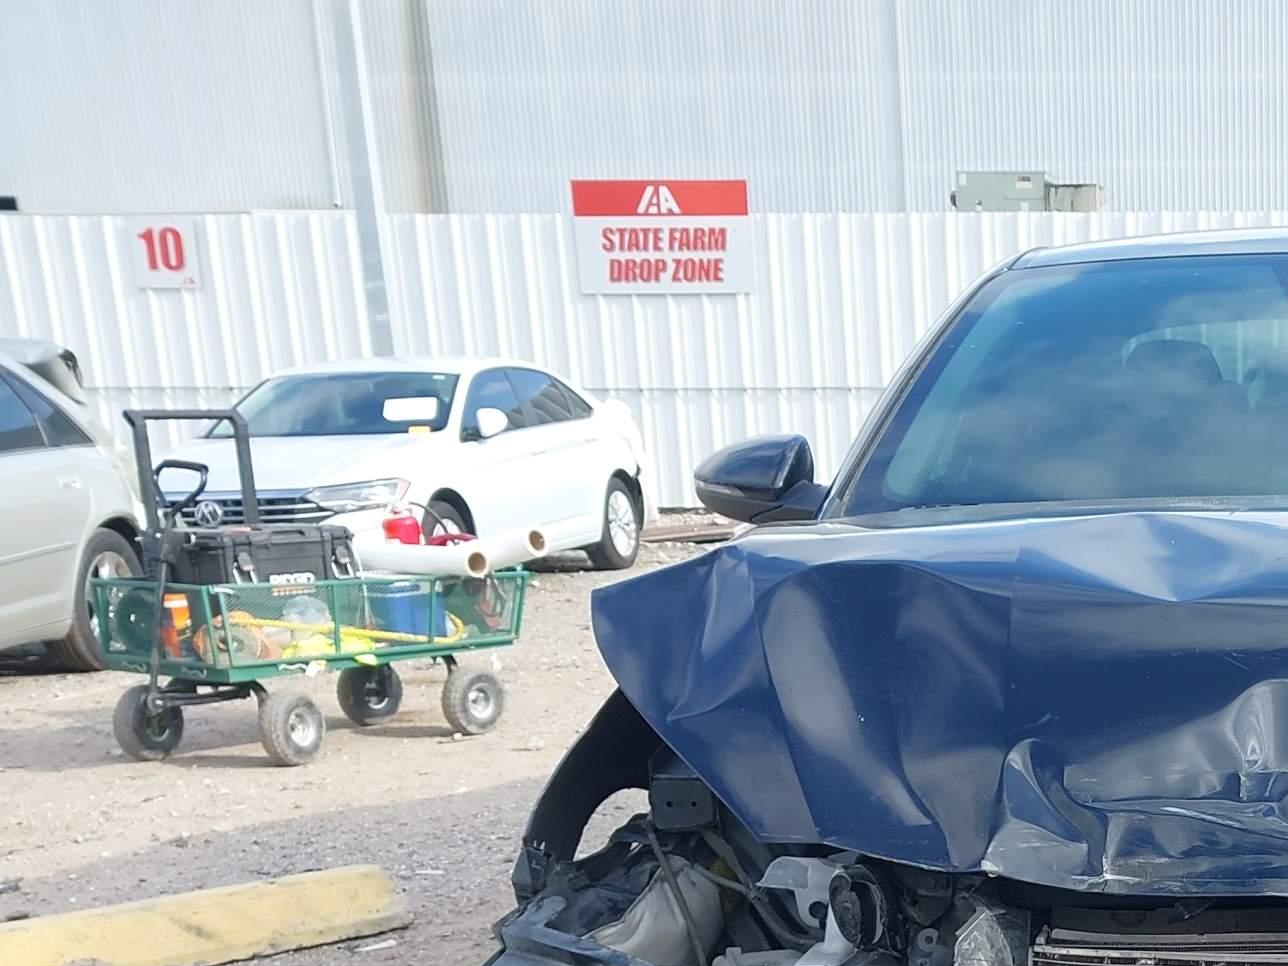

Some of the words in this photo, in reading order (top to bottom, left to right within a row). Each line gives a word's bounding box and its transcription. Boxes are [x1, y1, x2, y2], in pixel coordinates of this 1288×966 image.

[137, 227, 184, 271] 10
[602, 227, 664, 252] STATE
[668, 227, 727, 252] FARM
[609, 258, 667, 283] DROP
[671, 258, 724, 283] ZONE
